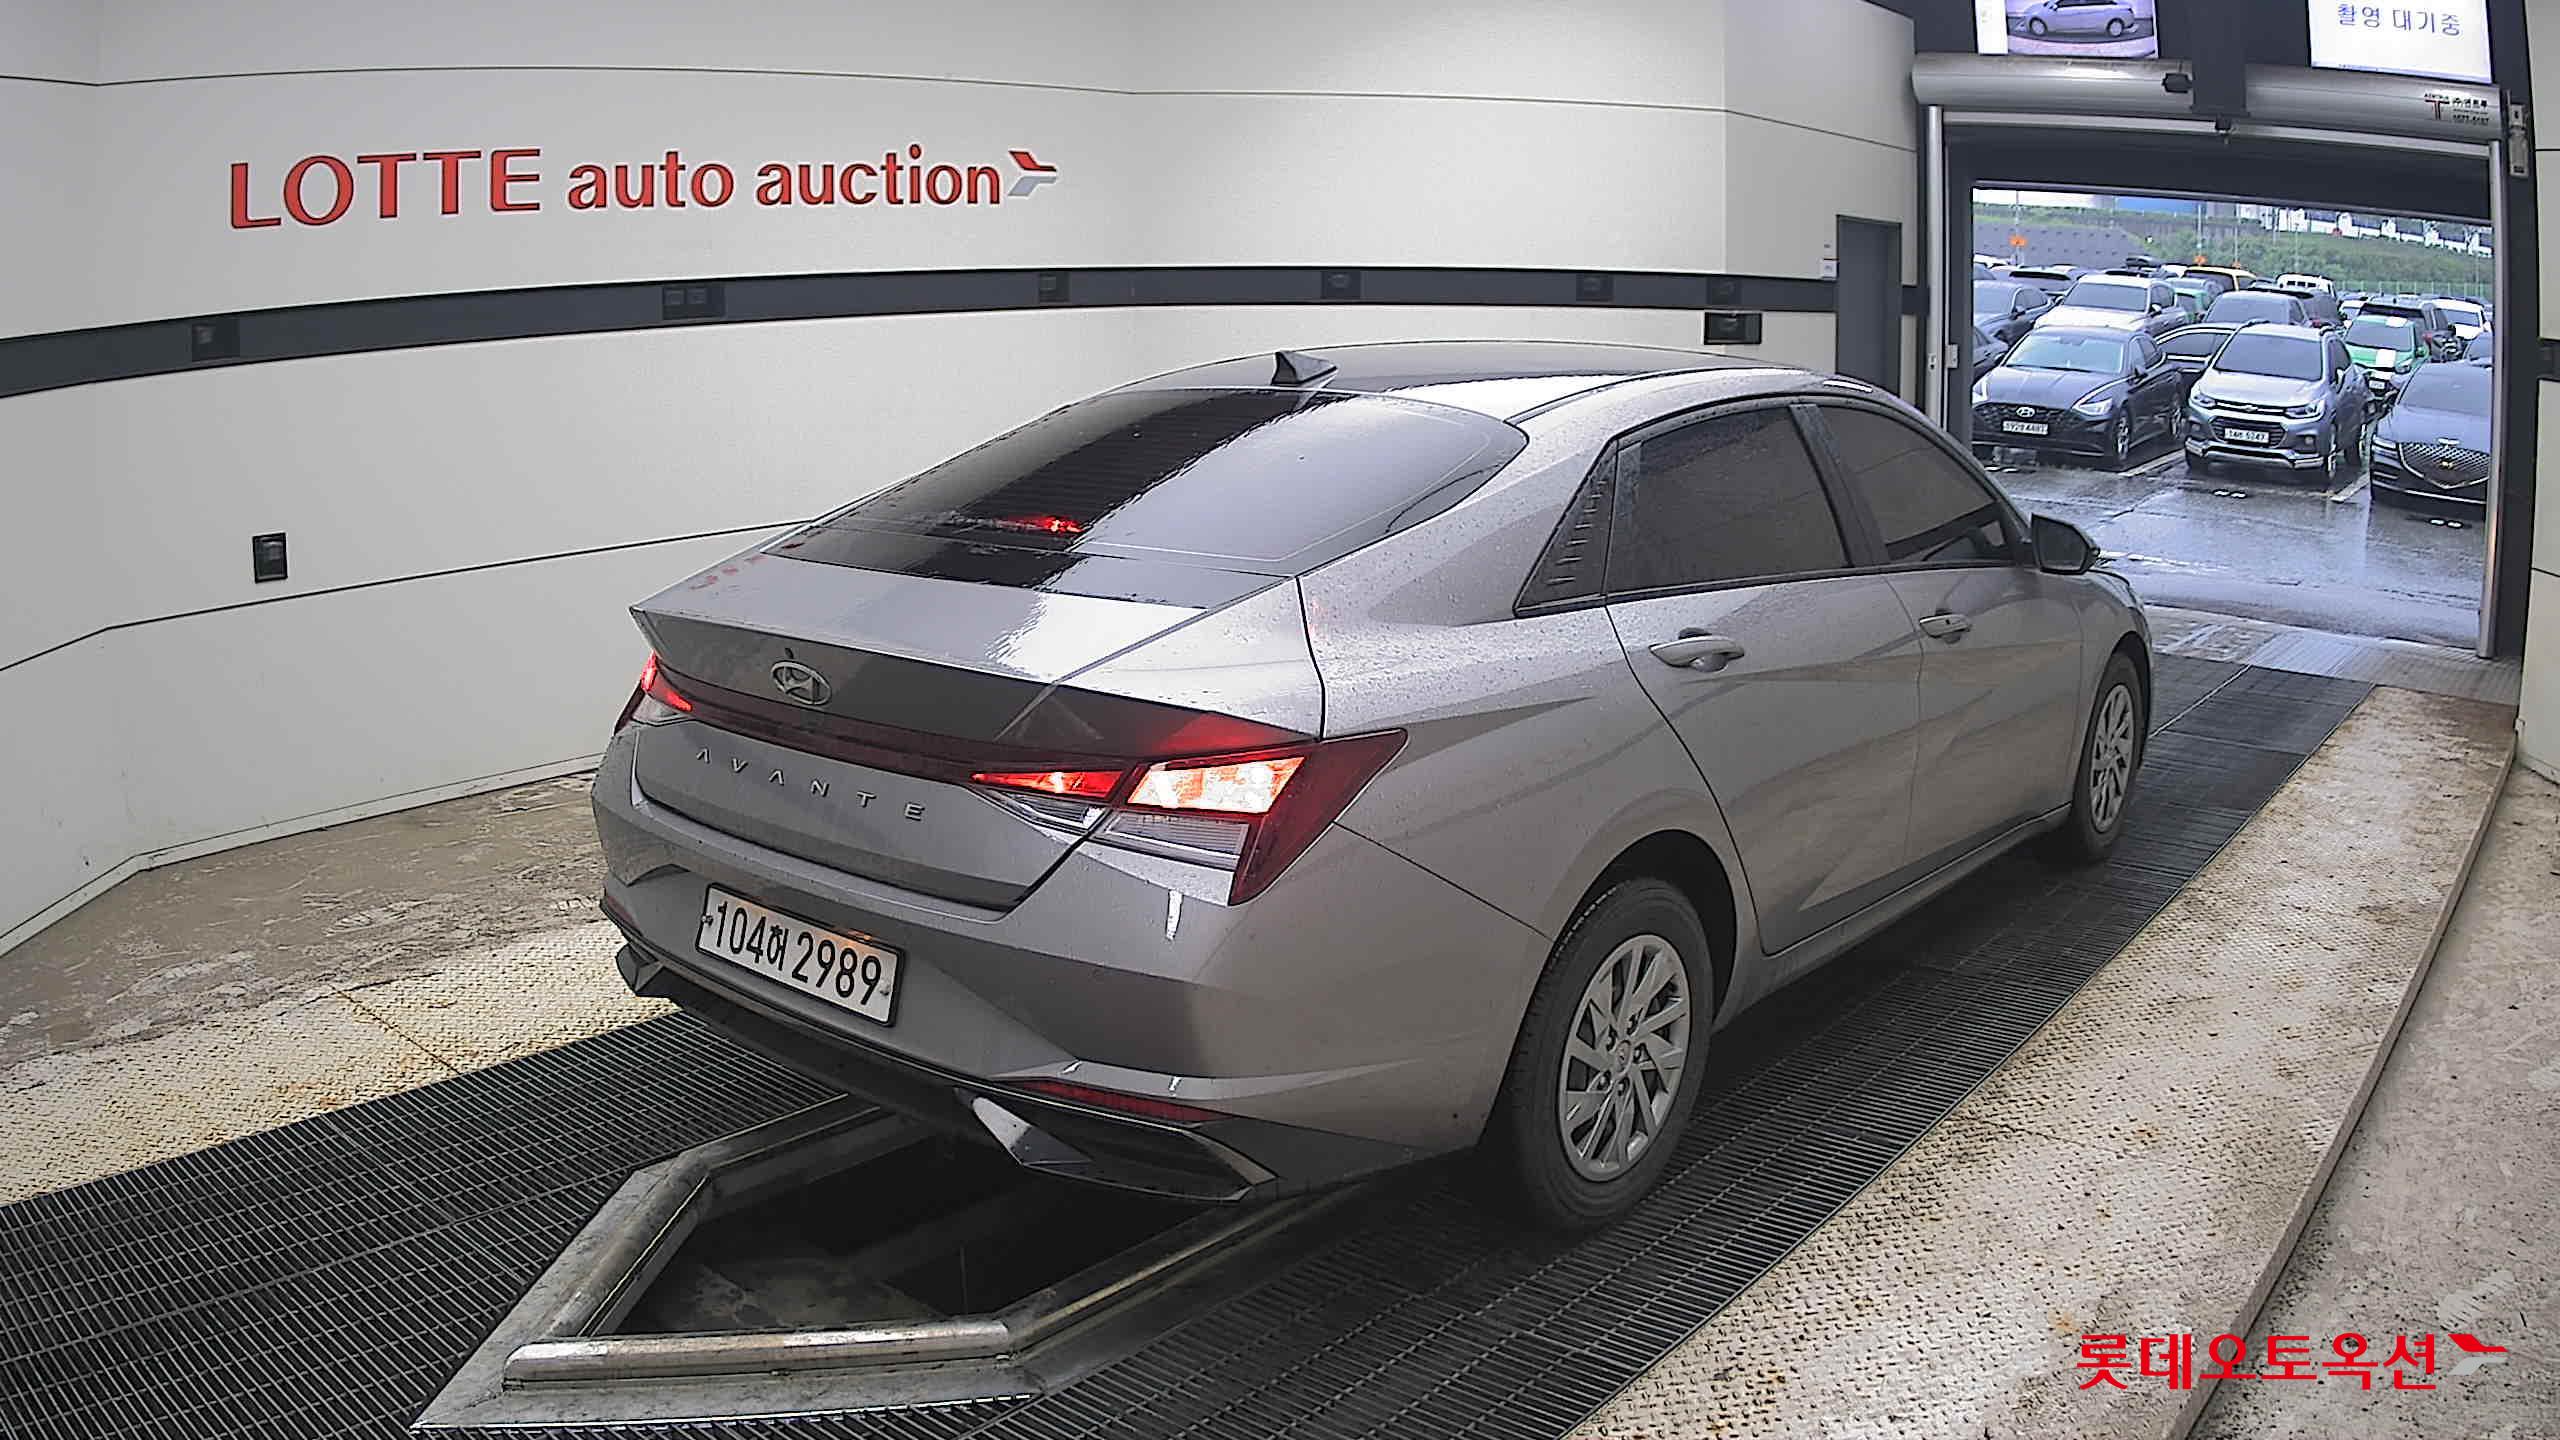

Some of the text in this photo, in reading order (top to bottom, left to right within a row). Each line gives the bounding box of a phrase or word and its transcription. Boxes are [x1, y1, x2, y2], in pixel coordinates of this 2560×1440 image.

[2337, 3, 2461, 37] 촬영 대기중
[231, 145, 1001, 230] LOTTE auto auction
[696, 747, 926, 821] AVANTE
